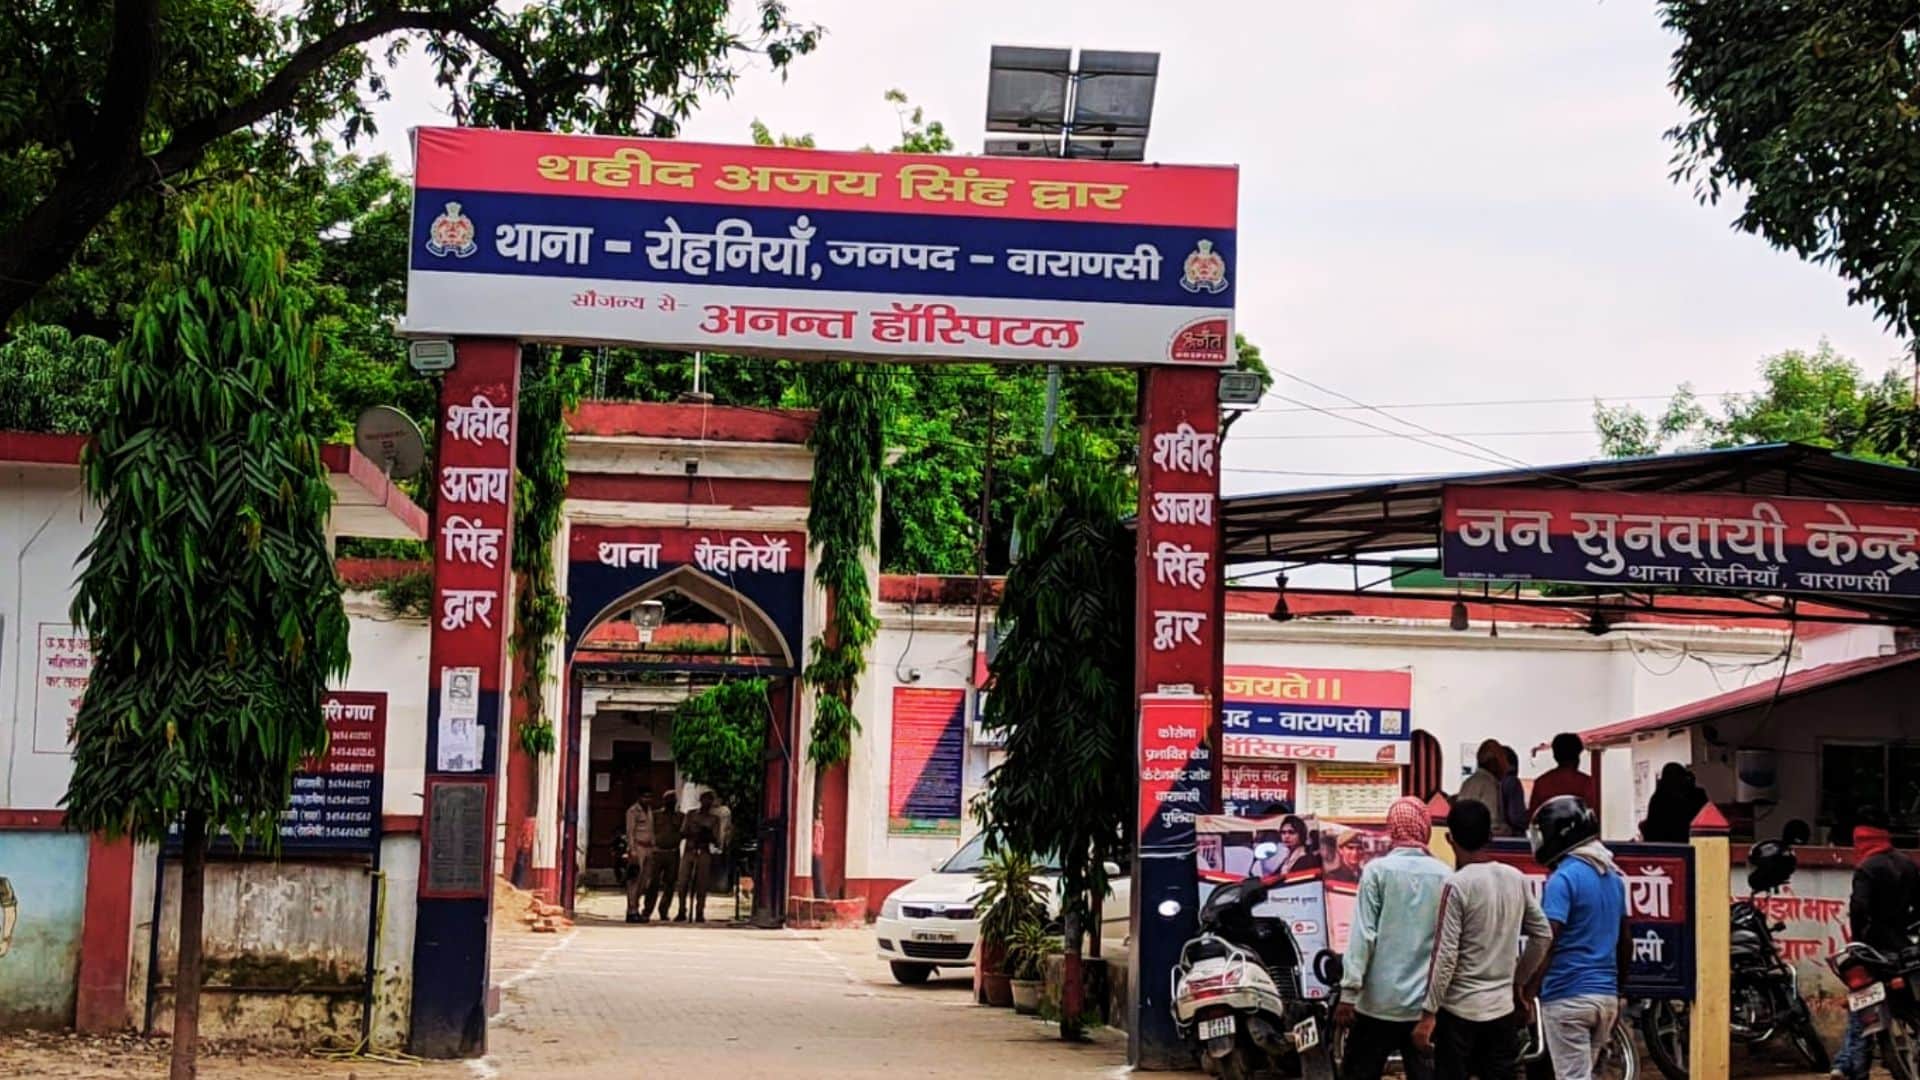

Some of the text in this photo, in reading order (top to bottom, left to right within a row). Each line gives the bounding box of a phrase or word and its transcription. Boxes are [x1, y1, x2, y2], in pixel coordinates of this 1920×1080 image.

[537, 148, 1129, 210] शहीद अजय सिंह द्वार
[496, 223, 595, 265] थाना
[826, 240, 960, 272] जनपद
[1006, 243, 1163, 281] वाराणसी
[571, 289, 645, 311] सौजन्य
[699, 304, 857, 340] अनन्त
[870, 302, 1084, 349] हॉस्पिटल
[446, 395, 512, 446] शहीद
[1152, 422, 1216, 476] शहीद
[441, 466, 509, 505] अजय
[1152, 491, 1215, 526] अजय
[441, 515, 504, 569] सिंह
[598, 541, 662, 570] थाना
[1456, 503, 1920, 577] जन सुनवायी केन्द्र
[1153, 541, 1210, 590] सिंह
[1628, 565, 1682, 584] थाना
[1799, 569, 1892, 593] वाराणसी
[441, 588, 497, 632] द्वार
[1153, 609, 1207, 651] द्वार
[1224, 672, 1311, 699] जयते
[345, 703, 376, 721] गण
[1222, 709, 1252, 728] पद
[1279, 709, 1372, 734] वाराणसी
[1157, 725, 1197, 739] कोरोना
[1155, 787, 1200, 803] वाराणसी
[1231, 766, 1260, 785] पुलिस
[1161, 808, 1195, 829] पुलिस
